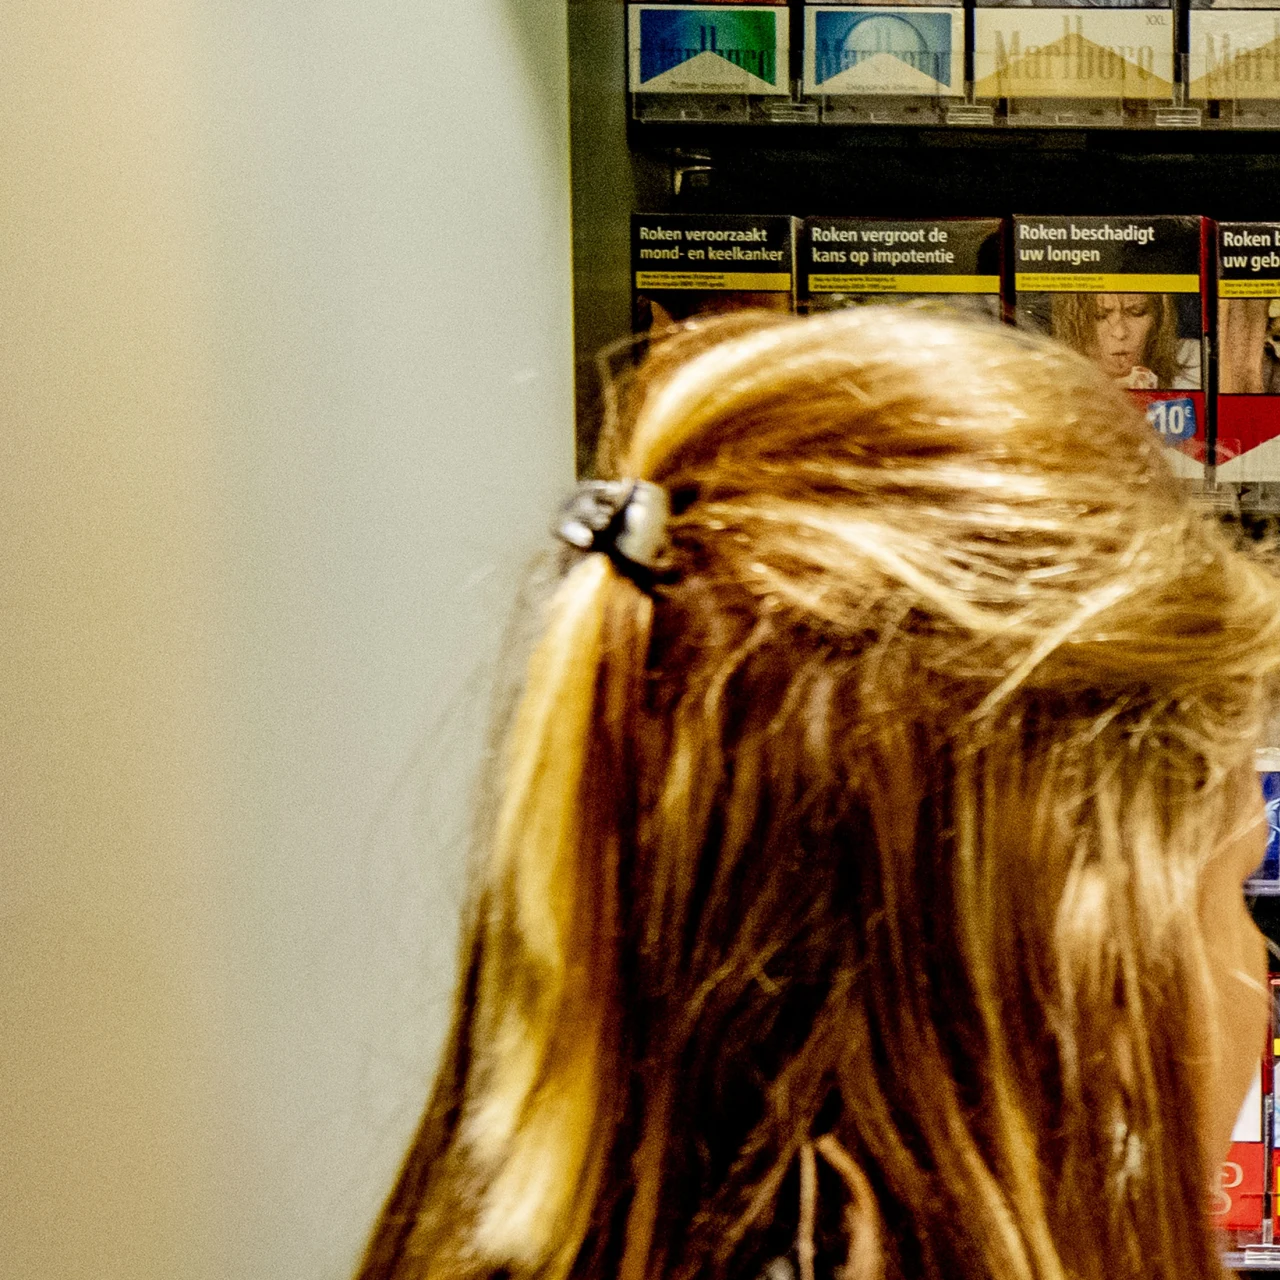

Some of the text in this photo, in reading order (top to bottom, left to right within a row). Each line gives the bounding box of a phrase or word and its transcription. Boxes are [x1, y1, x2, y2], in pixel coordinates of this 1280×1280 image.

[1145, 14, 1168, 27] XXL
[812, 227, 948, 246] Roken vergroot de
[813, 248, 955, 266] kans op impotentie
